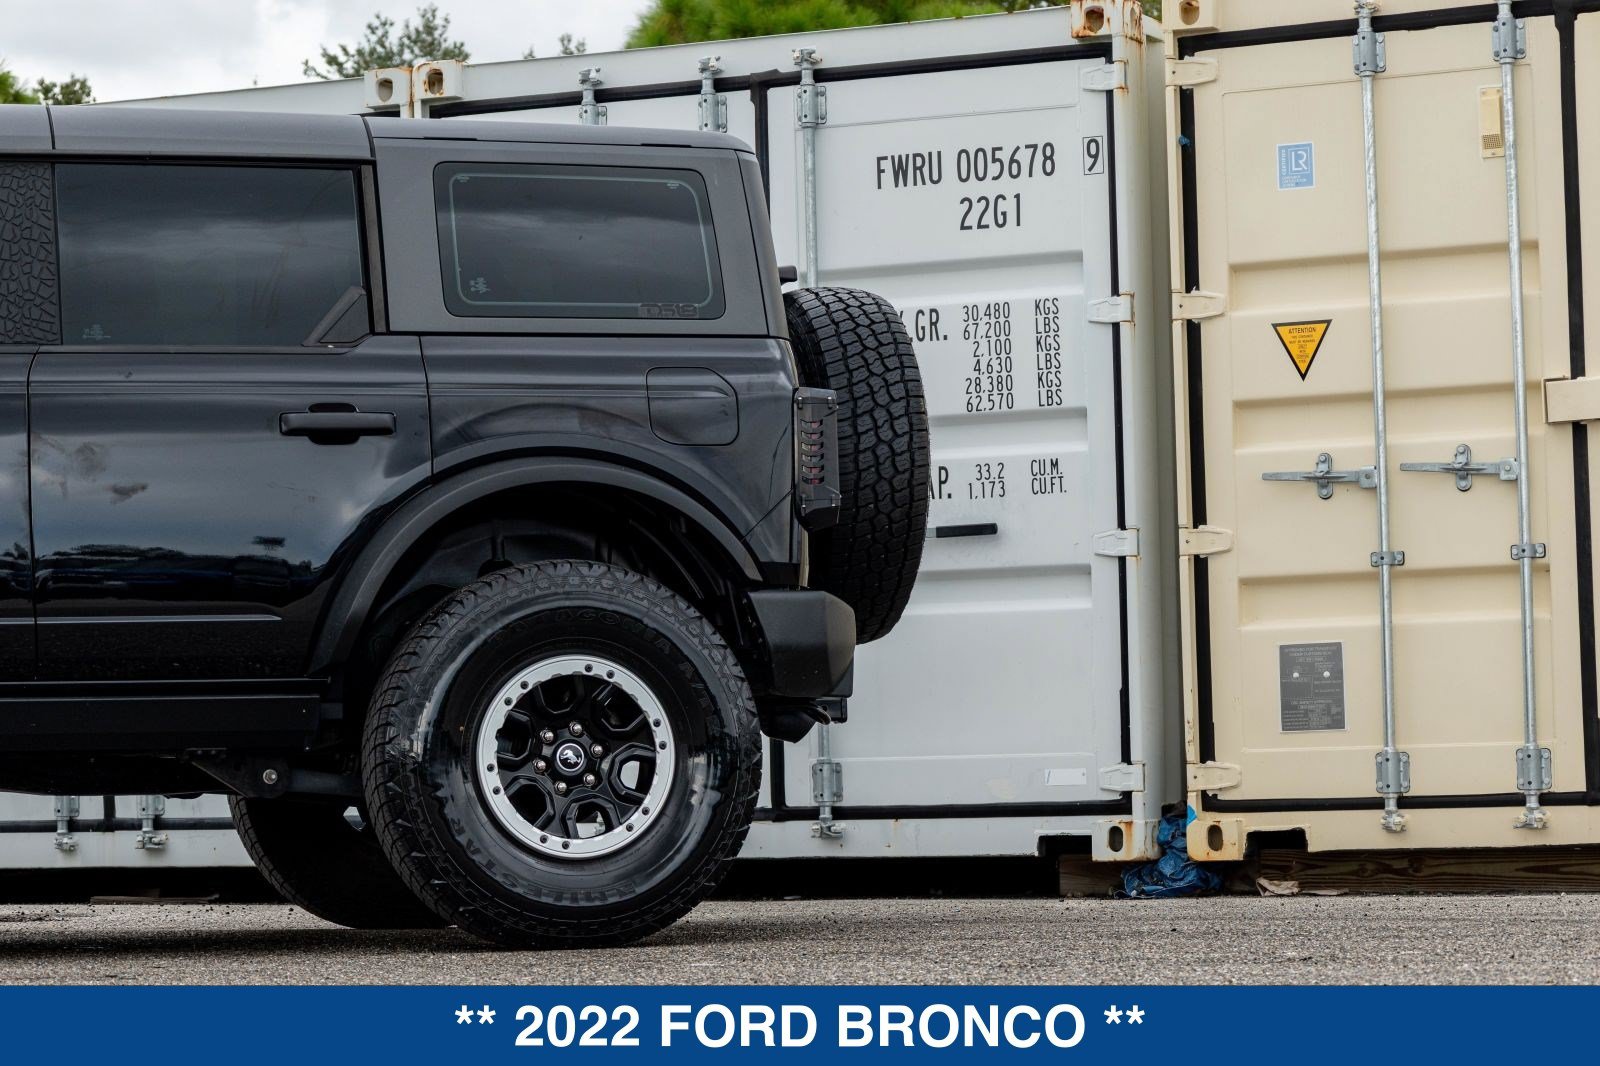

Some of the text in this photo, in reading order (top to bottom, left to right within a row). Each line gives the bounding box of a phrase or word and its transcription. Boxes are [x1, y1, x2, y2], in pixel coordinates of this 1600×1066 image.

[876, 138, 1101, 190] FWRU 005678 9
[959, 192, 1021, 231] 22G1
[962, 297, 1060, 322] 30,480 KGS
[914, 307, 949, 343] GR.
[963, 315, 1061, 341] 67,200 LBS
[1288, 326, 1317, 334] ATTENTION
[972, 333, 1061, 358] 2,100 KGS
[973, 351, 1062, 376] 4,630 LBS
[965, 370, 1062, 395] 28,380 KGS
[966, 387, 1063, 413] 62,570 LBS
[975, 457, 1063, 481] 33.2 CU.M.
[968, 475, 1067, 500] 1,173 CU.FT.
